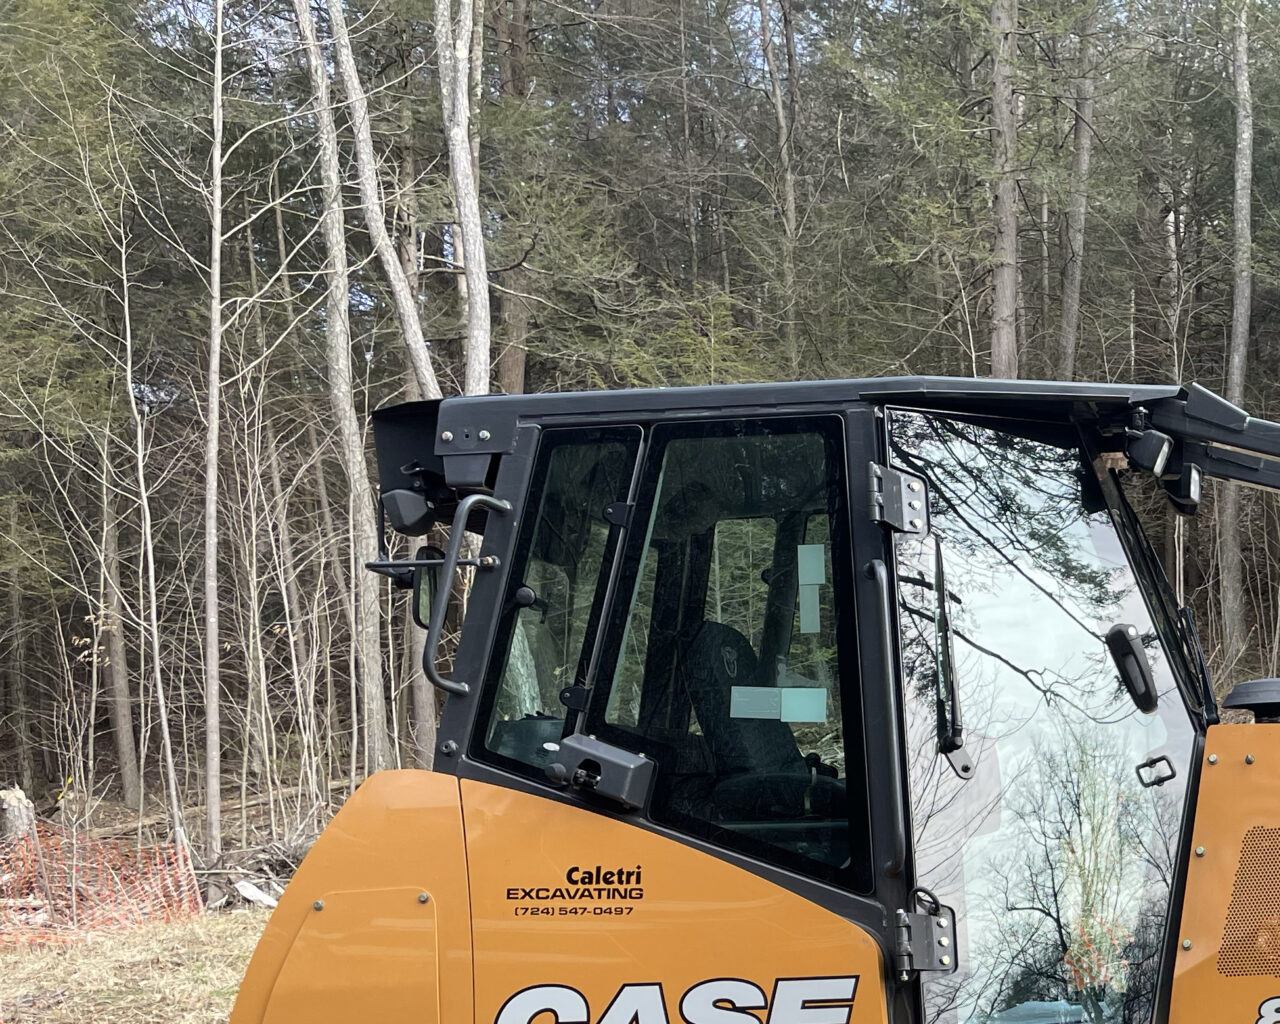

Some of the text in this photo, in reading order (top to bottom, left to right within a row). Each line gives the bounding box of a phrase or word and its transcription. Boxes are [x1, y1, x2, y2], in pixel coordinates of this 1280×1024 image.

[565, 864, 642, 886] Caletri
[505, 887, 644, 901] EXCAVATING
[514, 906, 634, 917] (724) 547-0497
